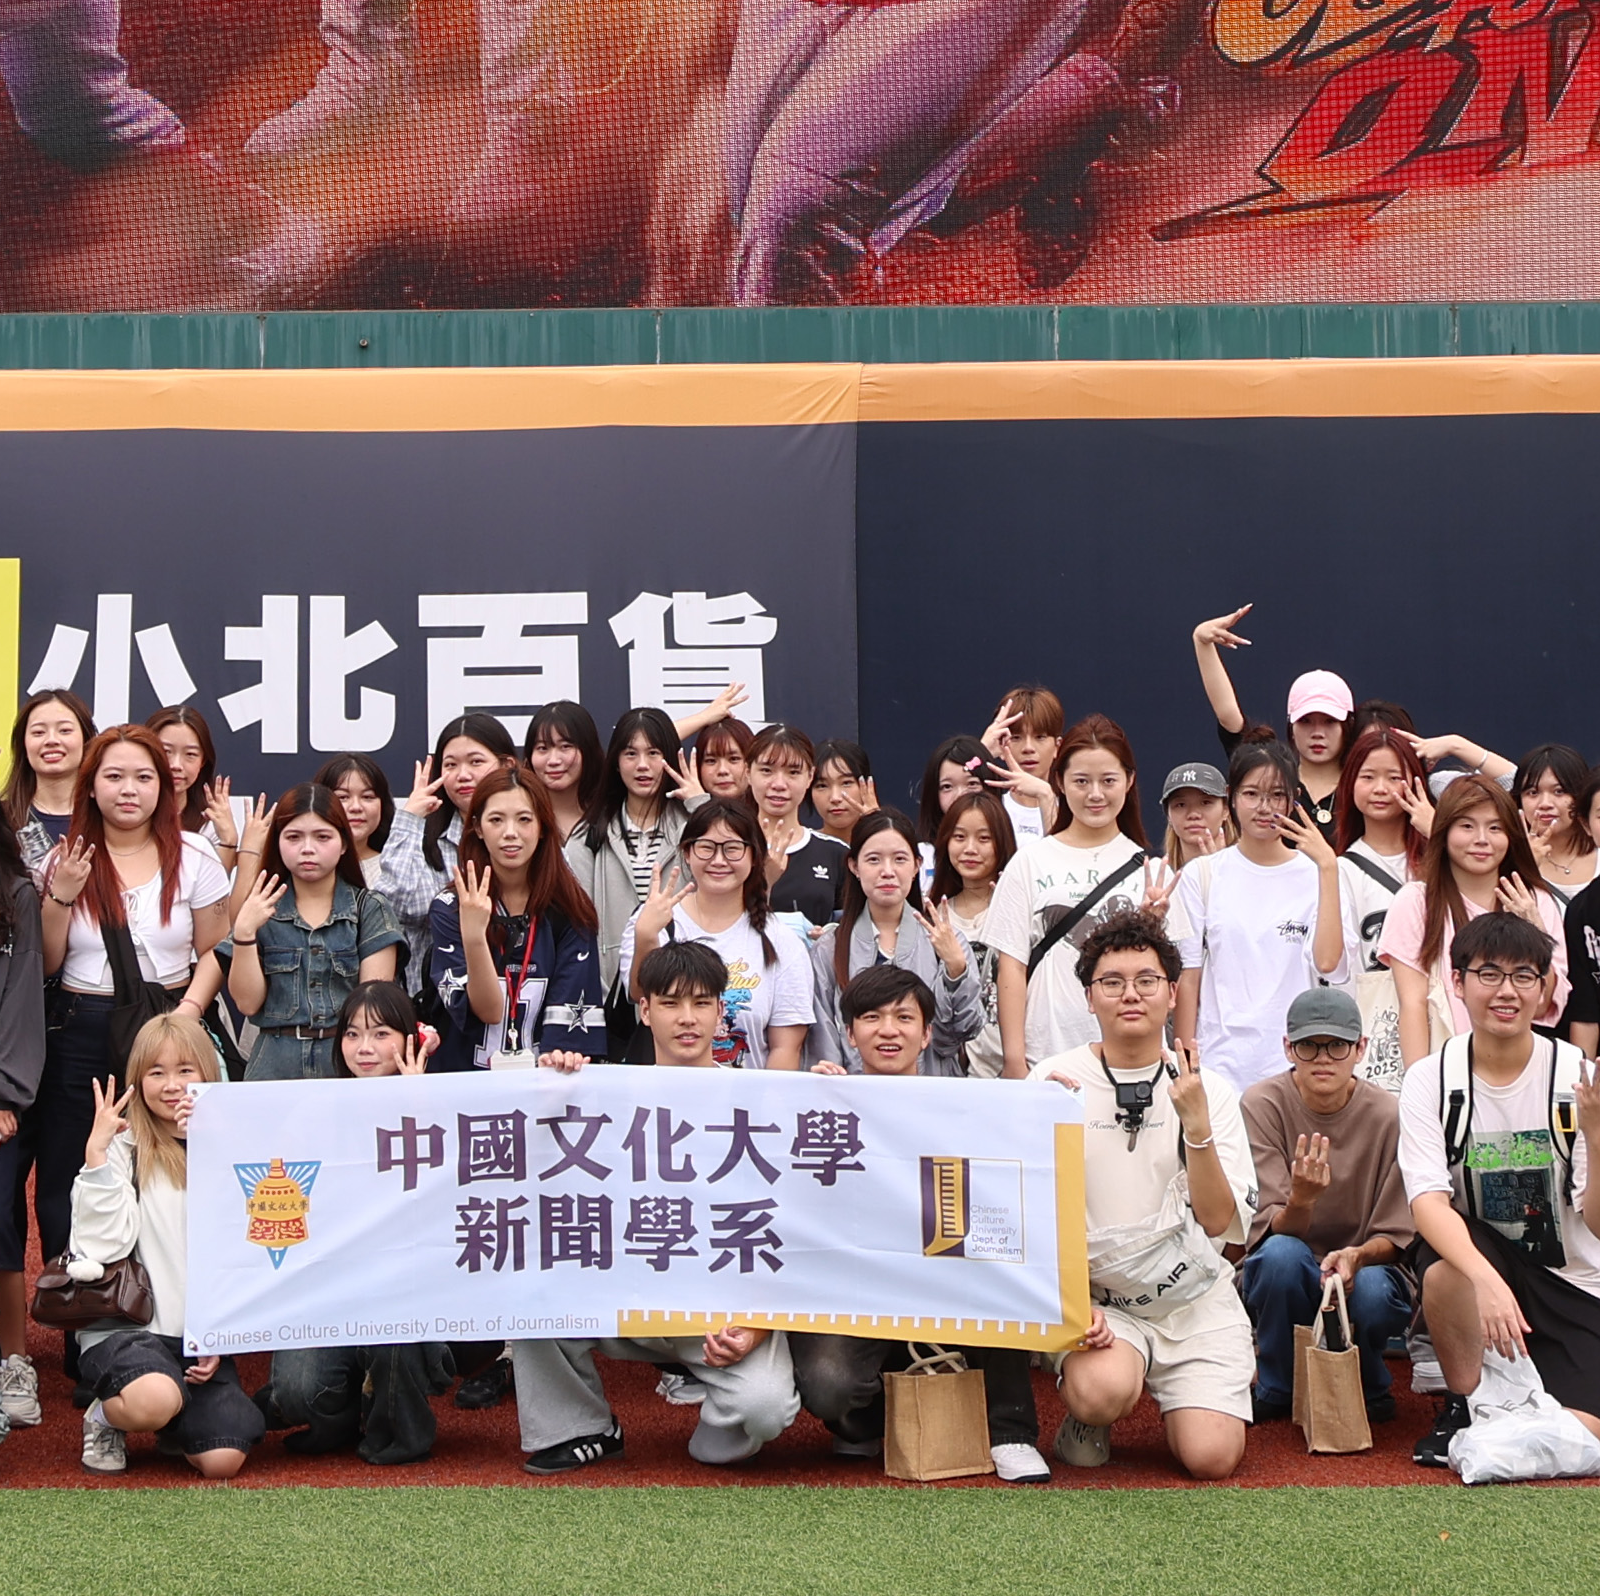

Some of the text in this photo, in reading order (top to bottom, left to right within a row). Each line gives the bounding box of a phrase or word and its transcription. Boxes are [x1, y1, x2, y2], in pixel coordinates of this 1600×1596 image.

[28, 591, 778, 754] 小北百貨
[1365, 1060, 1399, 1079] 2025
[1088, 1120, 1118, 1131] Home
[376, 1104, 866, 1192] 中國文化大學
[248, 1199, 308, 1212] 中國文化大學
[970, 1205, 1009, 1215] Chinese
[970, 1215, 1005, 1225] Culture
[455, 1193, 784, 1273] 新聞學系
[971, 1225, 1017, 1236] University
[971, 1234, 1009, 1245] Dept. of
[972, 1245, 1022, 1256] Journalism
[1157, 1261, 1190, 1297] AIR
[202, 1313, 600, 1349] Chinese Culture University Dept. of Journalism
